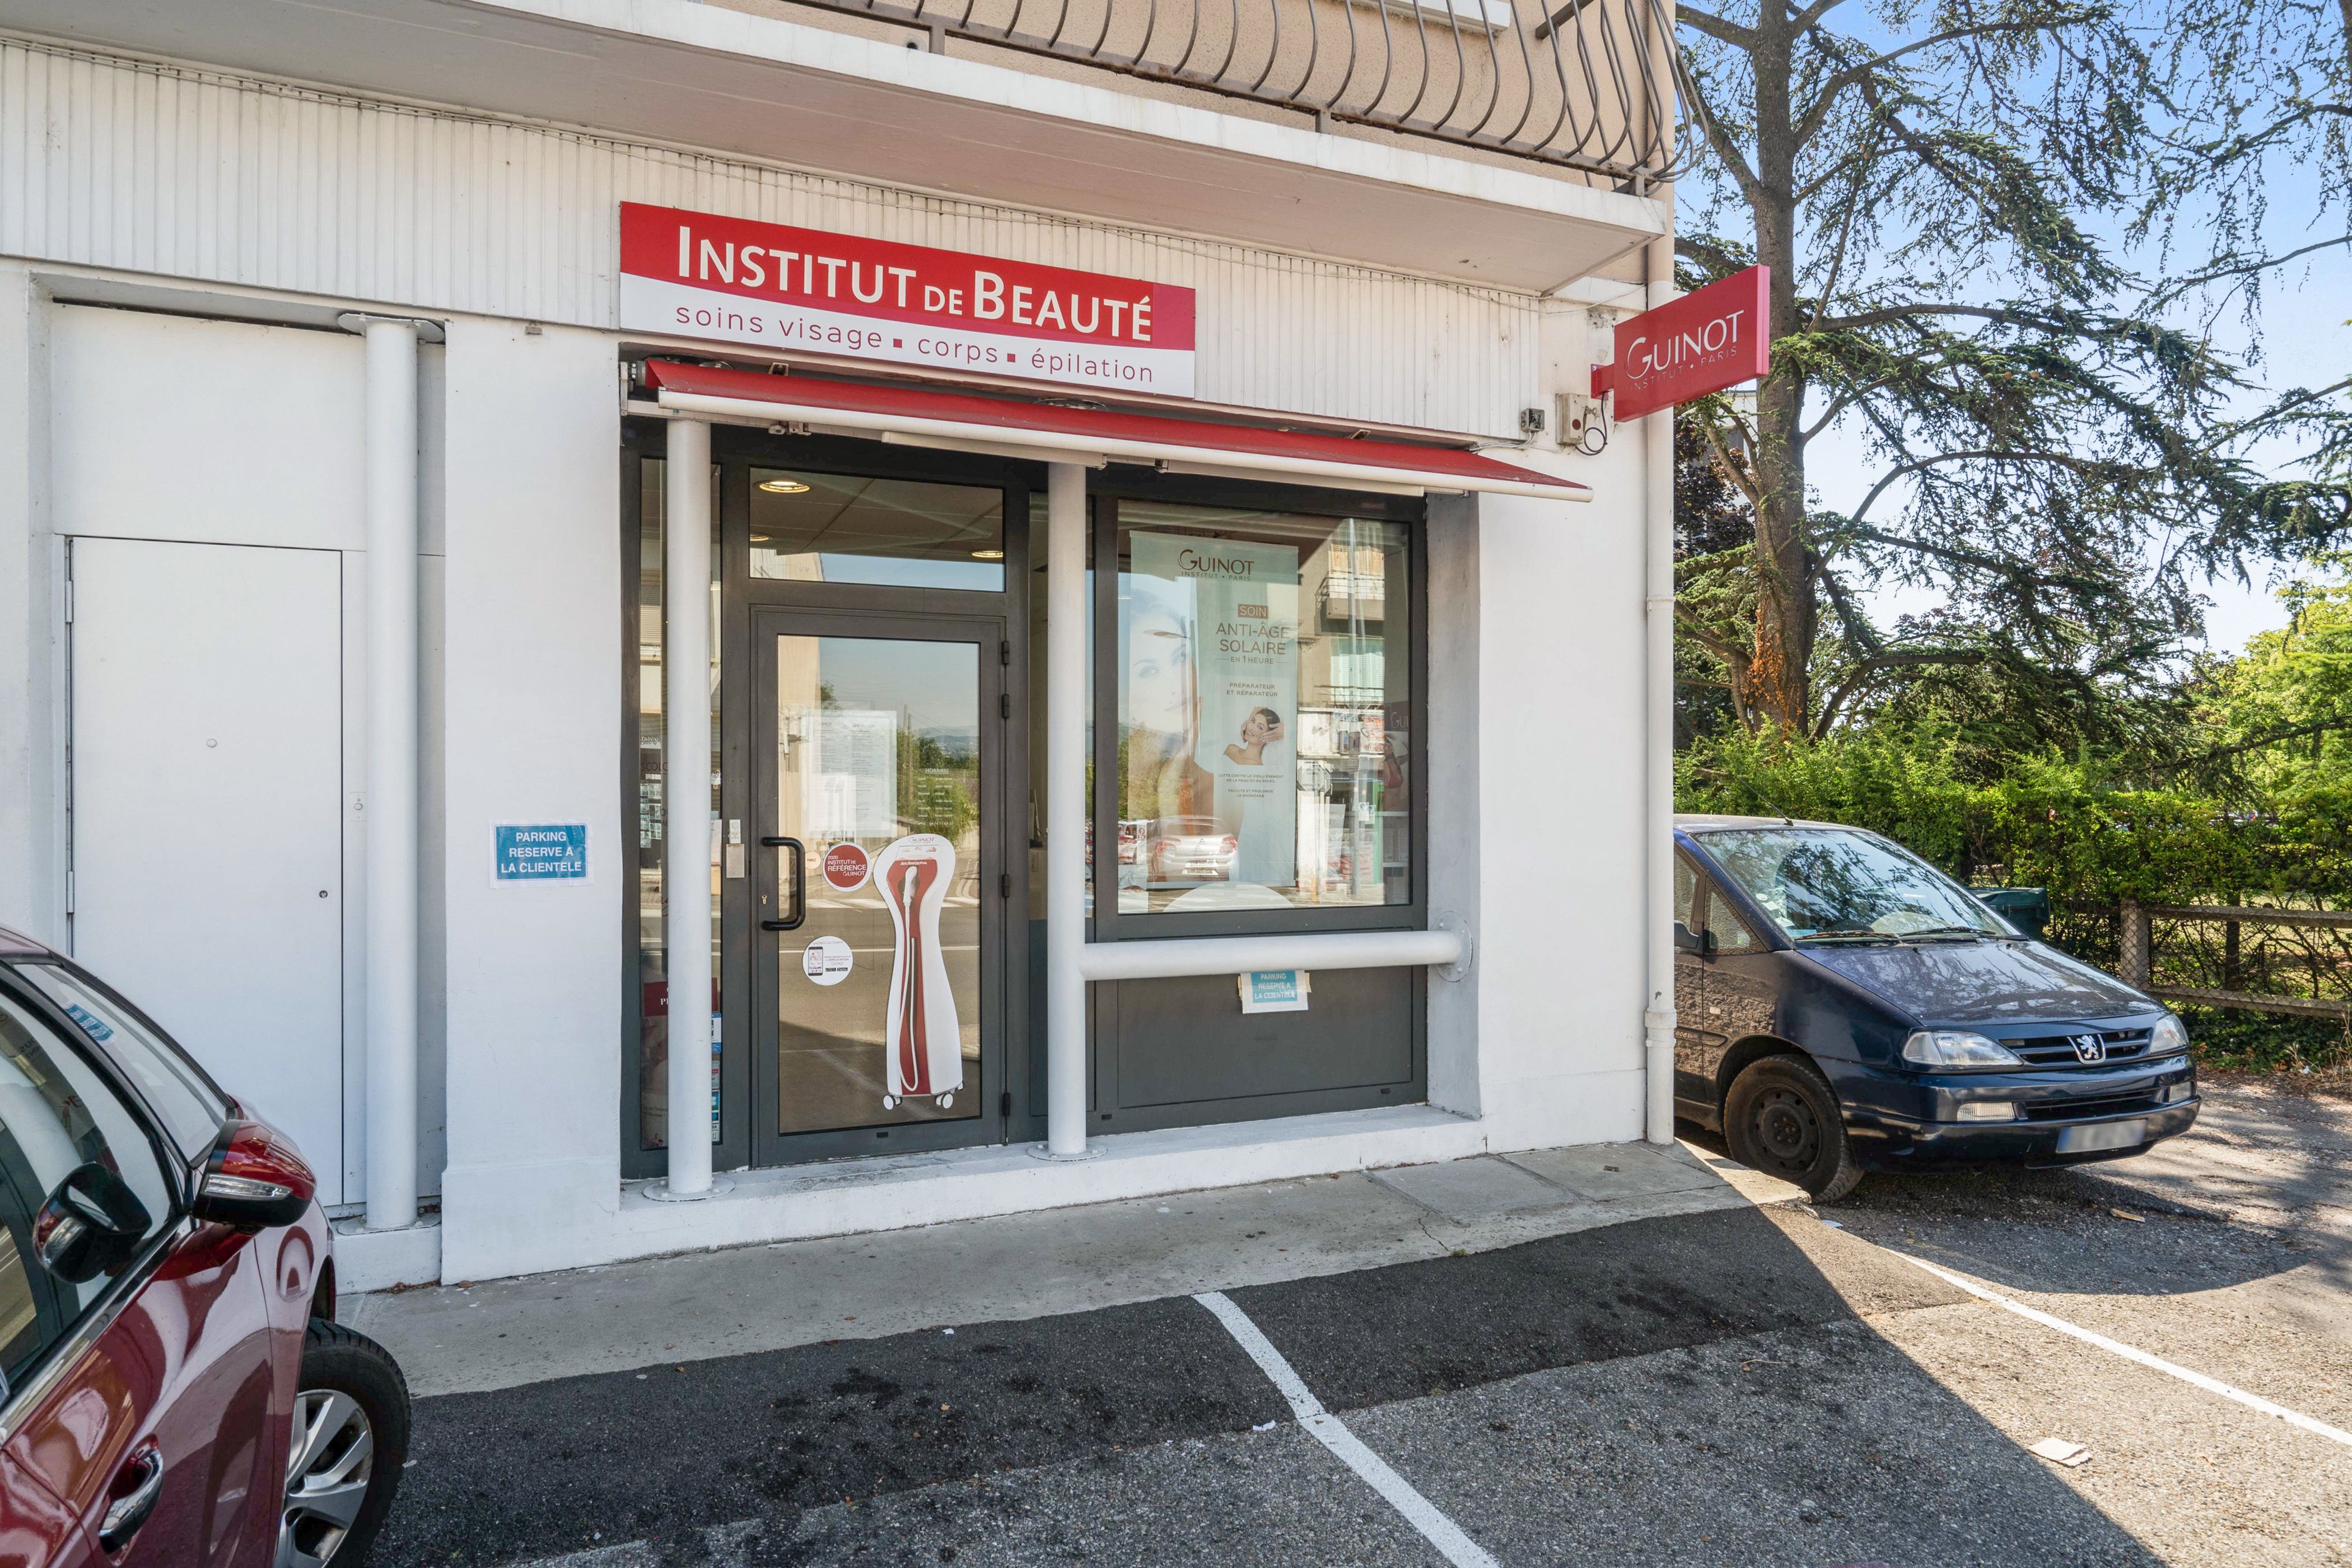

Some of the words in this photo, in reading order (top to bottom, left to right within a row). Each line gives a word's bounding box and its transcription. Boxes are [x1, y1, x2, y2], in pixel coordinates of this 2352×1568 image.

[678, 225, 917, 307] INSTITUT
[925, 286, 963, 315] DE
[974, 270, 1152, 342] BEAUTÉ
[676, 304, 763, 333] soins
[779, 318, 883, 349] visage
[917, 337, 998, 364] corps
[1031, 351, 1153, 384] épilation
[1626, 310, 1744, 380] GUINOT
[1630, 365, 1683, 392] INSTITUT
[1700, 346, 1737, 366] PARIS
[1178, 549, 1254, 575] GUINOT
[1240, 605, 1266, 617] SOIN
[1216, 622, 1290, 639] ANTI-ÂGE
[1220, 639, 1286, 655] SOLAIRE
[516, 832, 567, 842] PARKING
[509, 847, 562, 857] RESERVE
[566, 847, 573, 856] A
[501, 864, 516, 873] LA
[519, 862, 581, 872] CLIENTELE
